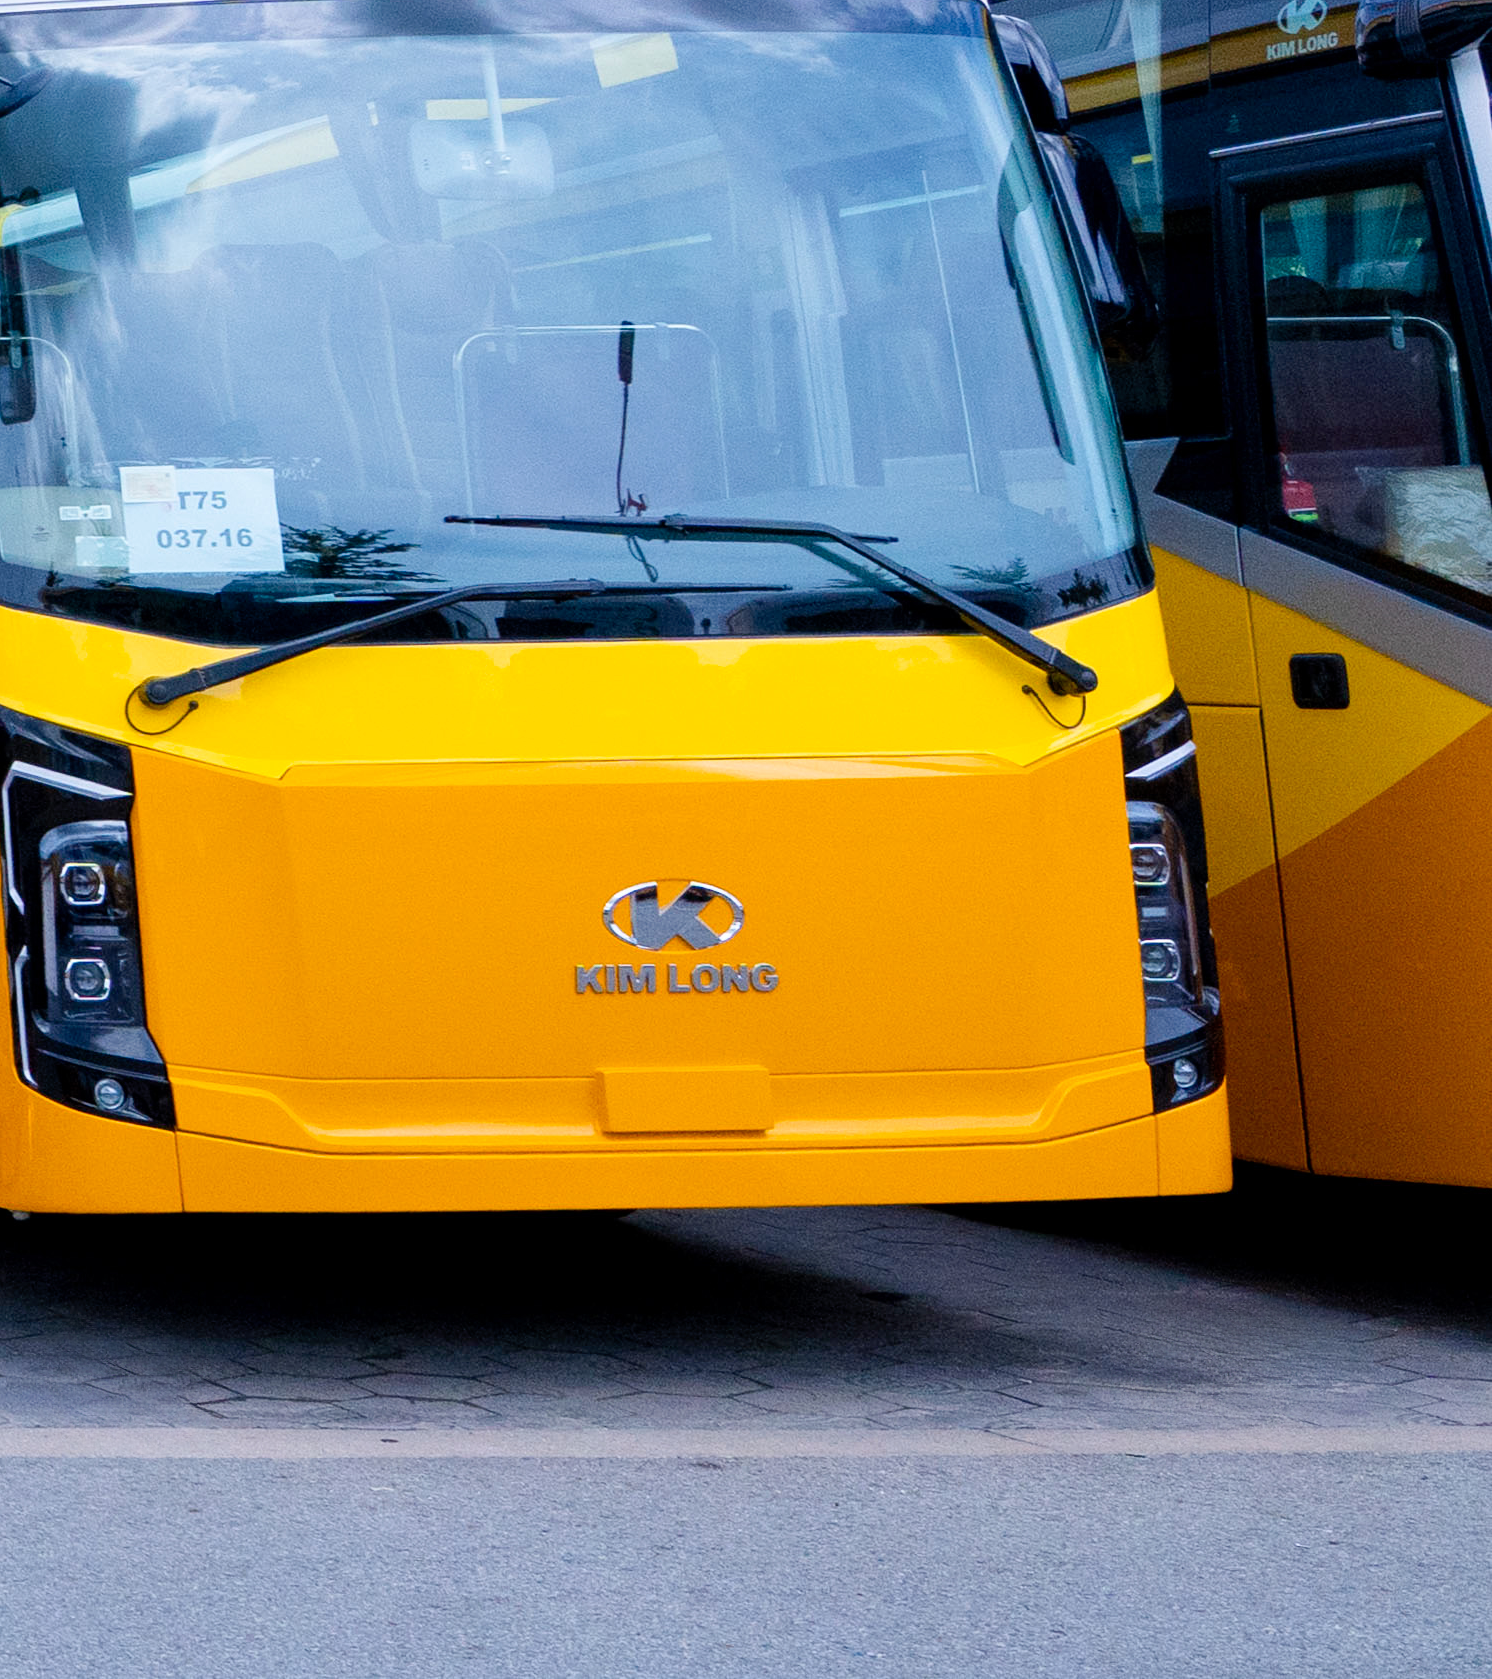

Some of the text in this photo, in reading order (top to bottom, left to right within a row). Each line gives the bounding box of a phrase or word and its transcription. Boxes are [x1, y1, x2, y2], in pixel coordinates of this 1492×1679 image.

[1266, 31, 1339, 61] KIM LONG
[177, 491, 228, 510] T75
[156, 529, 254, 549] 037.16
[575, 963, 779, 994] KIM LONG
